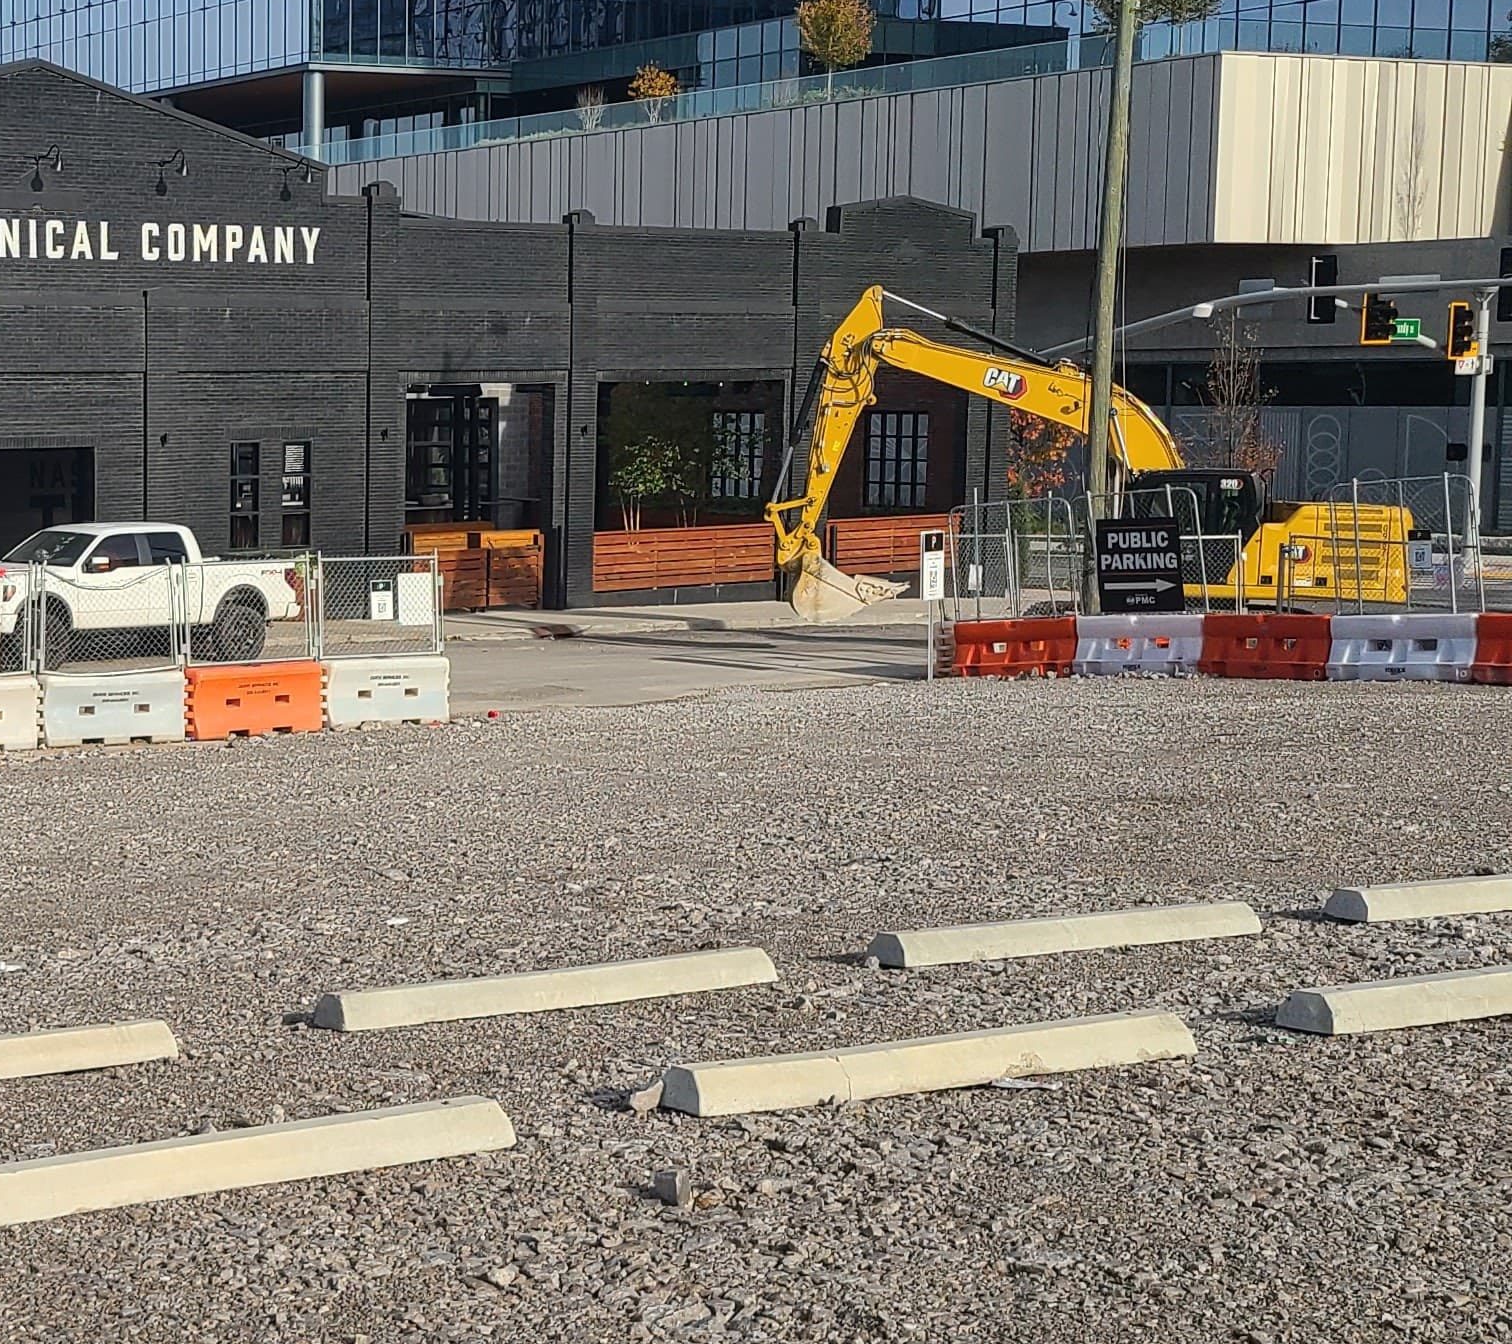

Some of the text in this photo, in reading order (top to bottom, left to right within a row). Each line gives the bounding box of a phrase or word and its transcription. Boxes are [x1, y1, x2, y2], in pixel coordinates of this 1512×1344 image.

[142, 223, 321, 264] COMPANY
[983, 367, 1021, 394] CAT
[1220, 479, 1238, 489] 320
[1107, 531, 1168, 549] PUBLIC
[1100, 552, 1178, 570] PARKING
[1135, 596, 1156, 605] PMC
